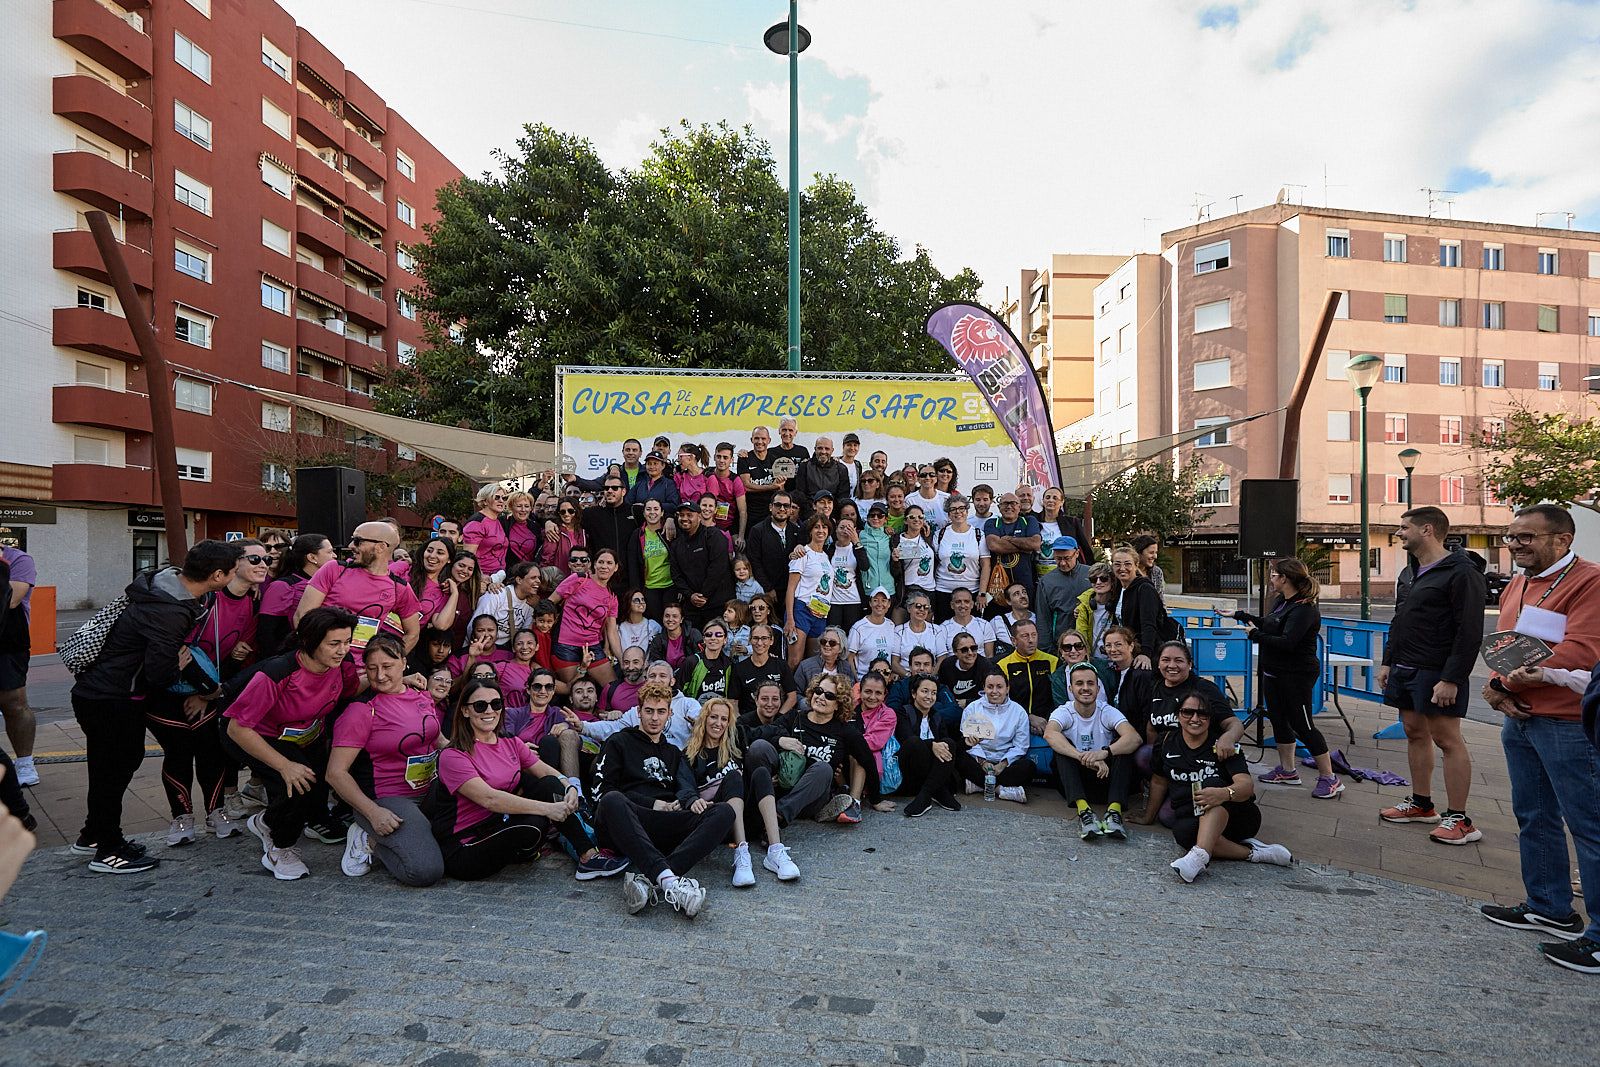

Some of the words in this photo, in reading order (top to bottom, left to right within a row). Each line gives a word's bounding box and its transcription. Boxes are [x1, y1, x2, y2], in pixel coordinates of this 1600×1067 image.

[572, 387, 671, 416] CURSA
[676, 390, 692, 401] DE
[842, 390, 856, 401] DE
[673, 404, 698, 417] LES
[700, 393, 833, 417] EMPRESES
[836, 404, 856, 416] LA
[861, 394, 958, 421] SAFOR
[979, 462, 994, 472] RH
[955, 680, 973, 689] NIKE
[1151, 713, 1162, 726] be
